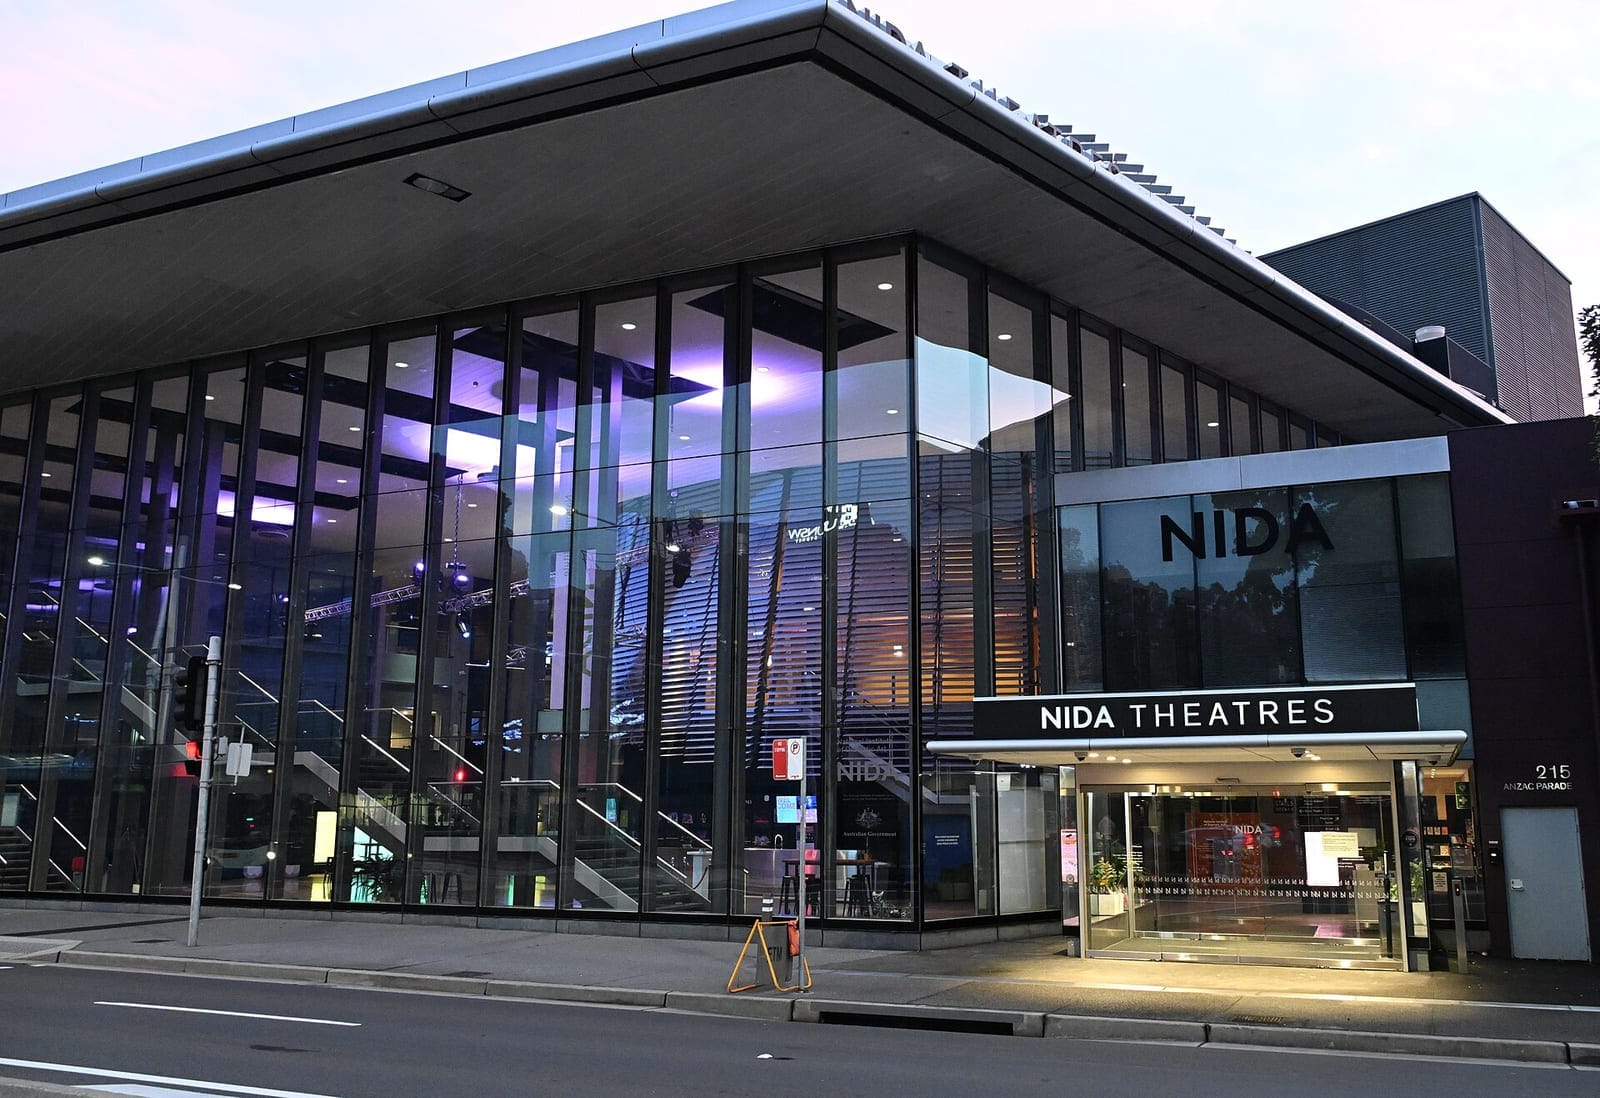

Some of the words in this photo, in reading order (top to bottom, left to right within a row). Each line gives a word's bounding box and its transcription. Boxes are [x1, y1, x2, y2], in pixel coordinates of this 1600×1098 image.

[1160, 503, 1334, 562] NIDA
[1040, 705, 1115, 731] NIDA
[1129, 698, 1336, 729] THEATRES
[836, 760, 897, 782] NIDA
[1536, 764, 1571, 780] 215
[1503, 782, 1535, 791] ANZAC
[1535, 782, 1573, 791] PARADE
[1234, 825, 1263, 835] NIDA
